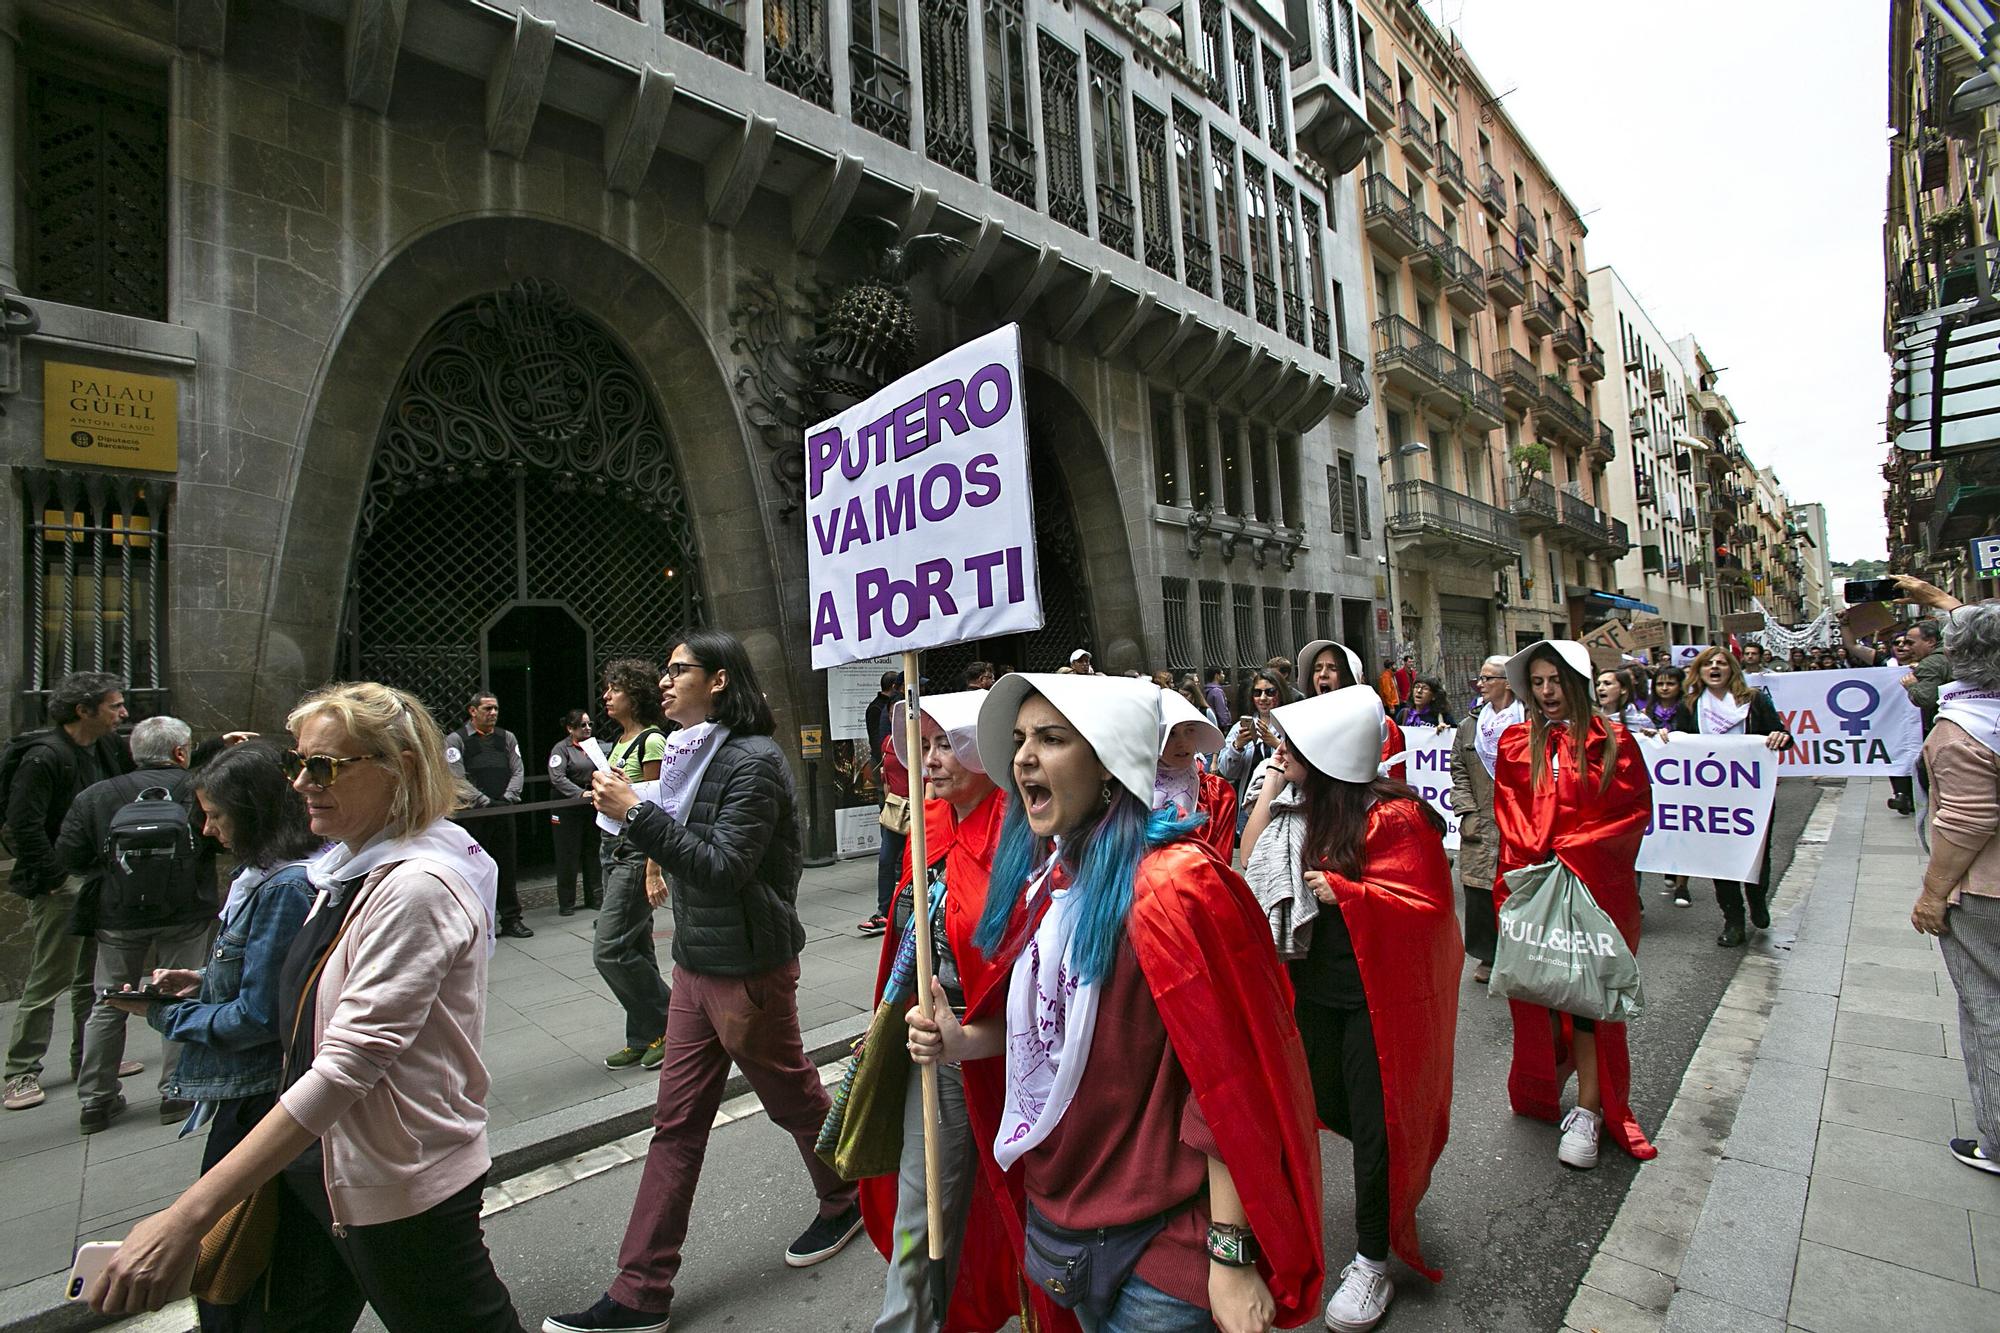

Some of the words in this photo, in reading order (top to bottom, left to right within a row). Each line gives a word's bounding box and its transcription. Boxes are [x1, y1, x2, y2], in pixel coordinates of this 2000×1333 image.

[70, 397, 156, 420] GÜELL
[71, 380, 154, 403] PALAU
[70, 417, 115, 428] ANTONI
[808, 363, 1013, 500] PUTERO
[97, 442, 141, 452] Barcelona
[812, 453, 1002, 556] VAMOS
[812, 590, 844, 646] A
[964, 546, 1025, 609] TI
[1649, 751, 1761, 790] CIÓN
[1501, 916, 1617, 958] PULL&BEAR
